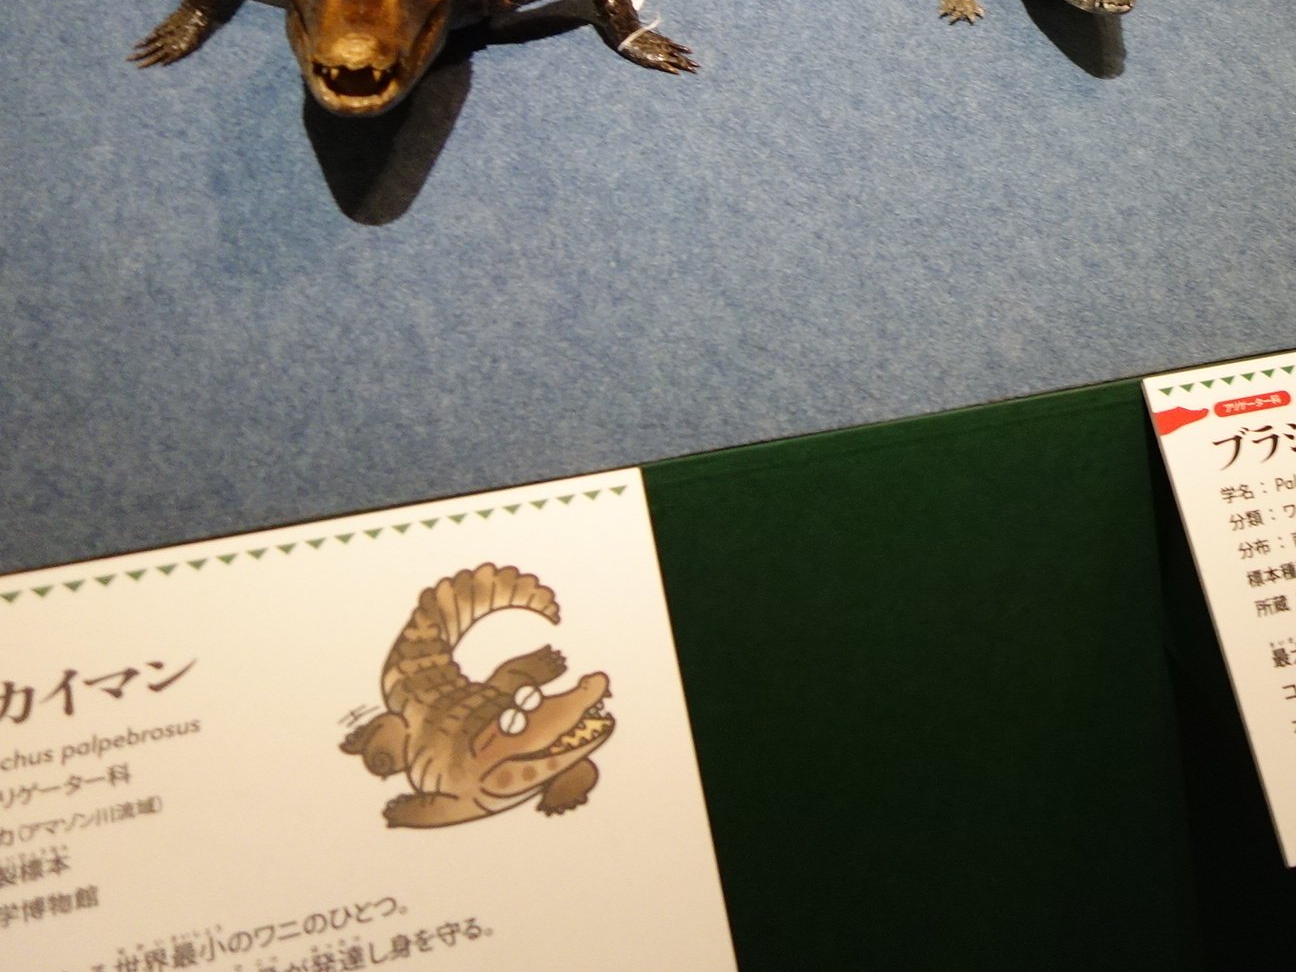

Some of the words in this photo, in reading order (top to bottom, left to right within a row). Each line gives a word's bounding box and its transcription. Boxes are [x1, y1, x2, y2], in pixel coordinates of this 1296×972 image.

[0, 658, 198, 724] カイマン
[61, 719, 202, 765] palpebrosus
